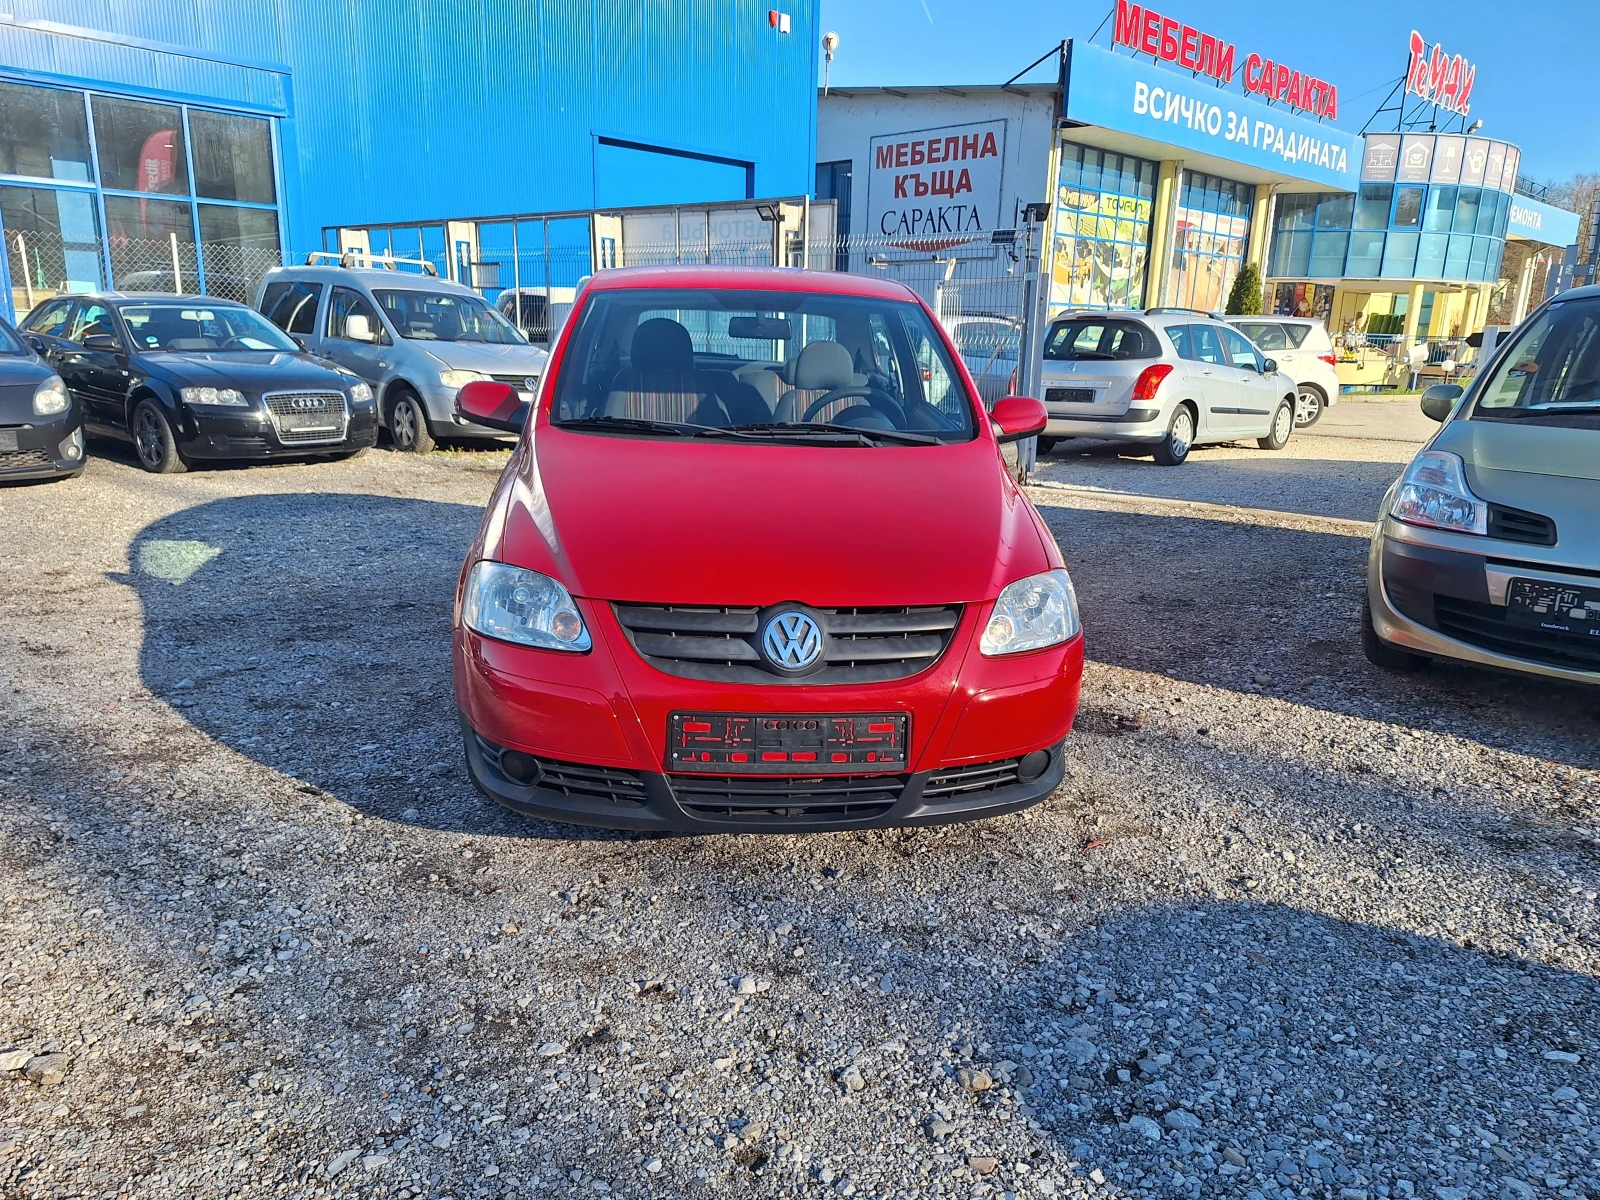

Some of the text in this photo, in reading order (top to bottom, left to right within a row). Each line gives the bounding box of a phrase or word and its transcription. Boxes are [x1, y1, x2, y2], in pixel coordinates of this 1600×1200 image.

[1114, 0, 1338, 121] МЕБЕЛИ САРАКТА
[1133, 80, 1348, 173] ВСИЧКО ЗА ГРАДИНАТА
[875, 131, 998, 170] МЕБЕЛНА
[894, 168, 973, 199] КЪЩА
[880, 204, 982, 236] САРАКТА
[1511, 204, 1542, 231] ЕМОНТА
